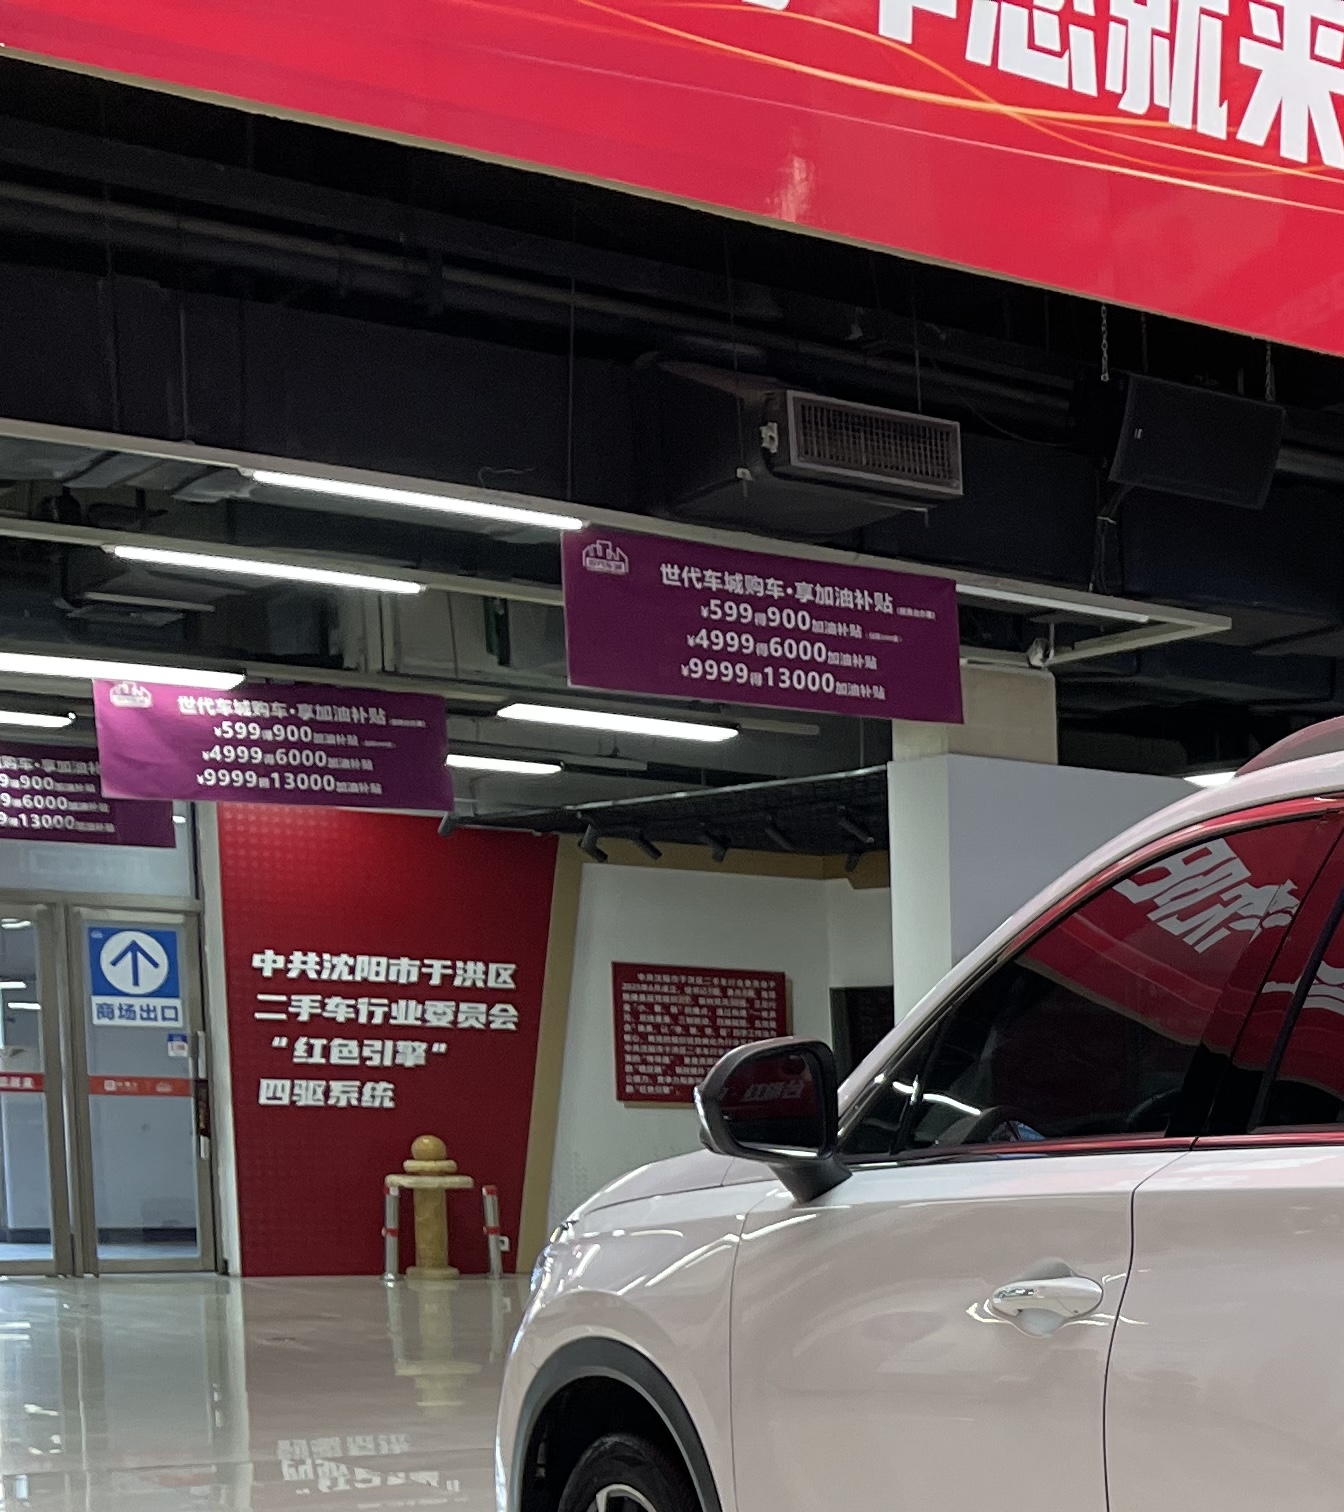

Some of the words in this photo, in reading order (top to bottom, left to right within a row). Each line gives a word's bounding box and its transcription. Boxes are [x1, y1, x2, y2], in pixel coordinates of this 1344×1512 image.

[251, 949, 518, 990] 中共沈阳市于洪区
[96, 1002, 179, 1022] 商场出口
[253, 993, 519, 1031] 二手车行业委员会
[258, 1077, 396, 1108] 四驱系统
